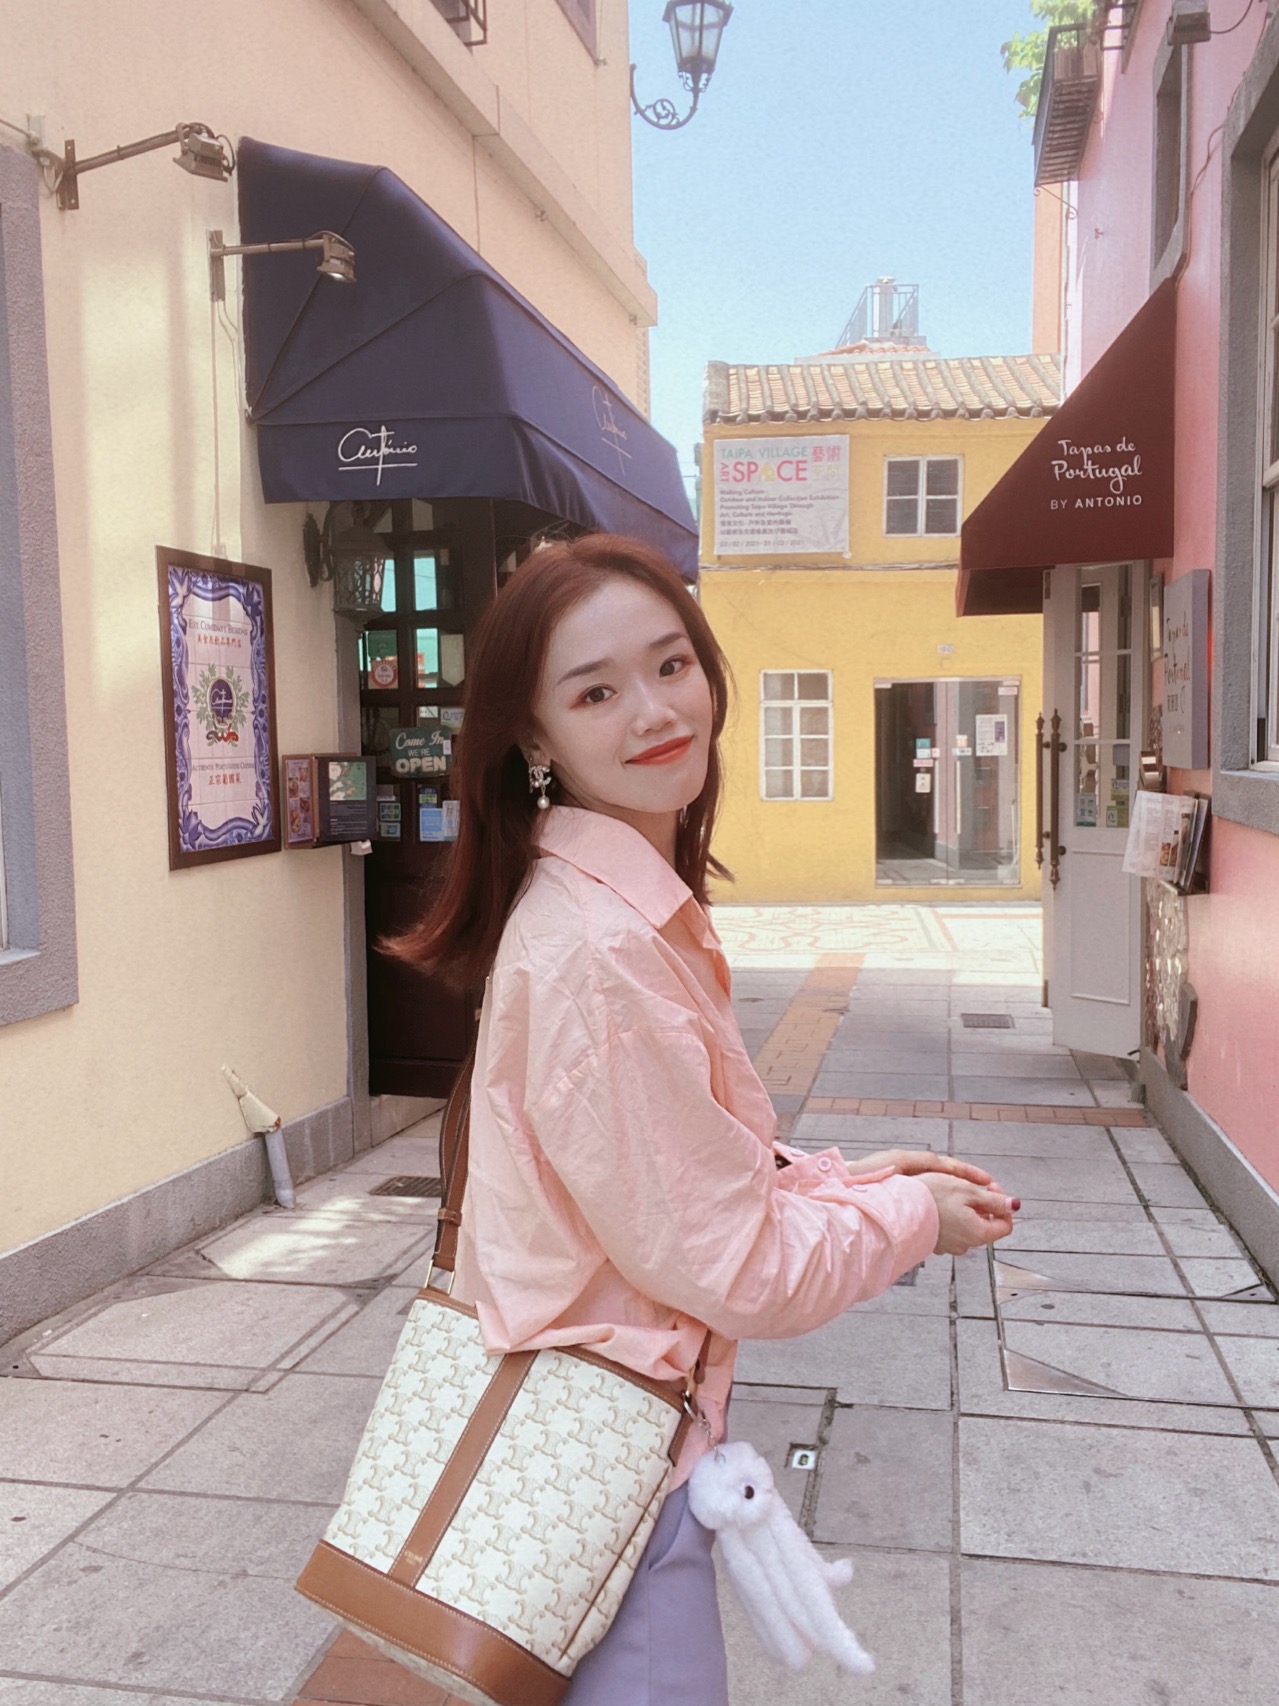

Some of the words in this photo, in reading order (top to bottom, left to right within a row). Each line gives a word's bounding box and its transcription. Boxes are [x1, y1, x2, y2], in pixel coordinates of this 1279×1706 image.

[720, 447, 754, 459] TAIPA
[759, 446, 808, 458] VILLAGE
[1058, 439, 1111, 468] Tapas
[1116, 436, 1136, 451] de
[720, 462, 730, 482] ART
[1051, 455, 1142, 494] Portugal
[1051, 499, 1068, 509] BY
[1075, 495, 1142, 508] ANTONIO
[395, 732, 426, 750] Come
[429, 730, 445, 746] In
[396, 755, 447, 773] OPEN
